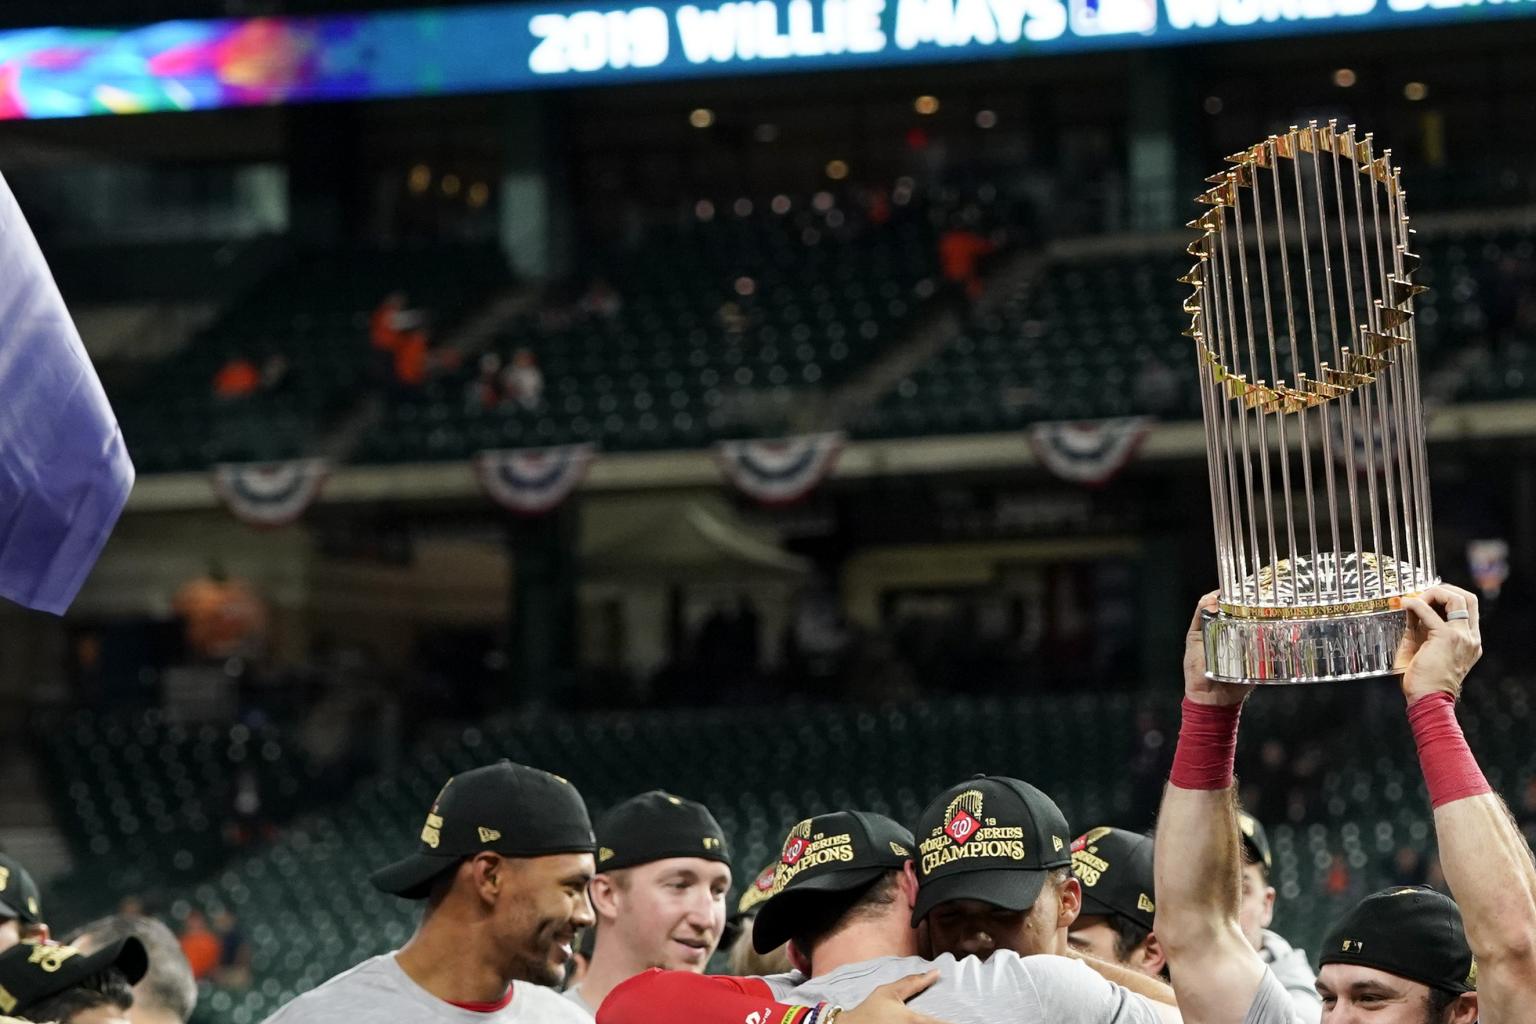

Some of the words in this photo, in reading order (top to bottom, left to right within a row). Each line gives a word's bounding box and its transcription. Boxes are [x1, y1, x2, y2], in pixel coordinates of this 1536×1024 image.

[676, 0, 887, 63] WILLIE
[895, 0, 1067, 49] MAYS
[804, 833, 851, 856] SERIES
[975, 826, 1024, 842] SERIES
[921, 840, 1025, 876] CHAMPIONS
